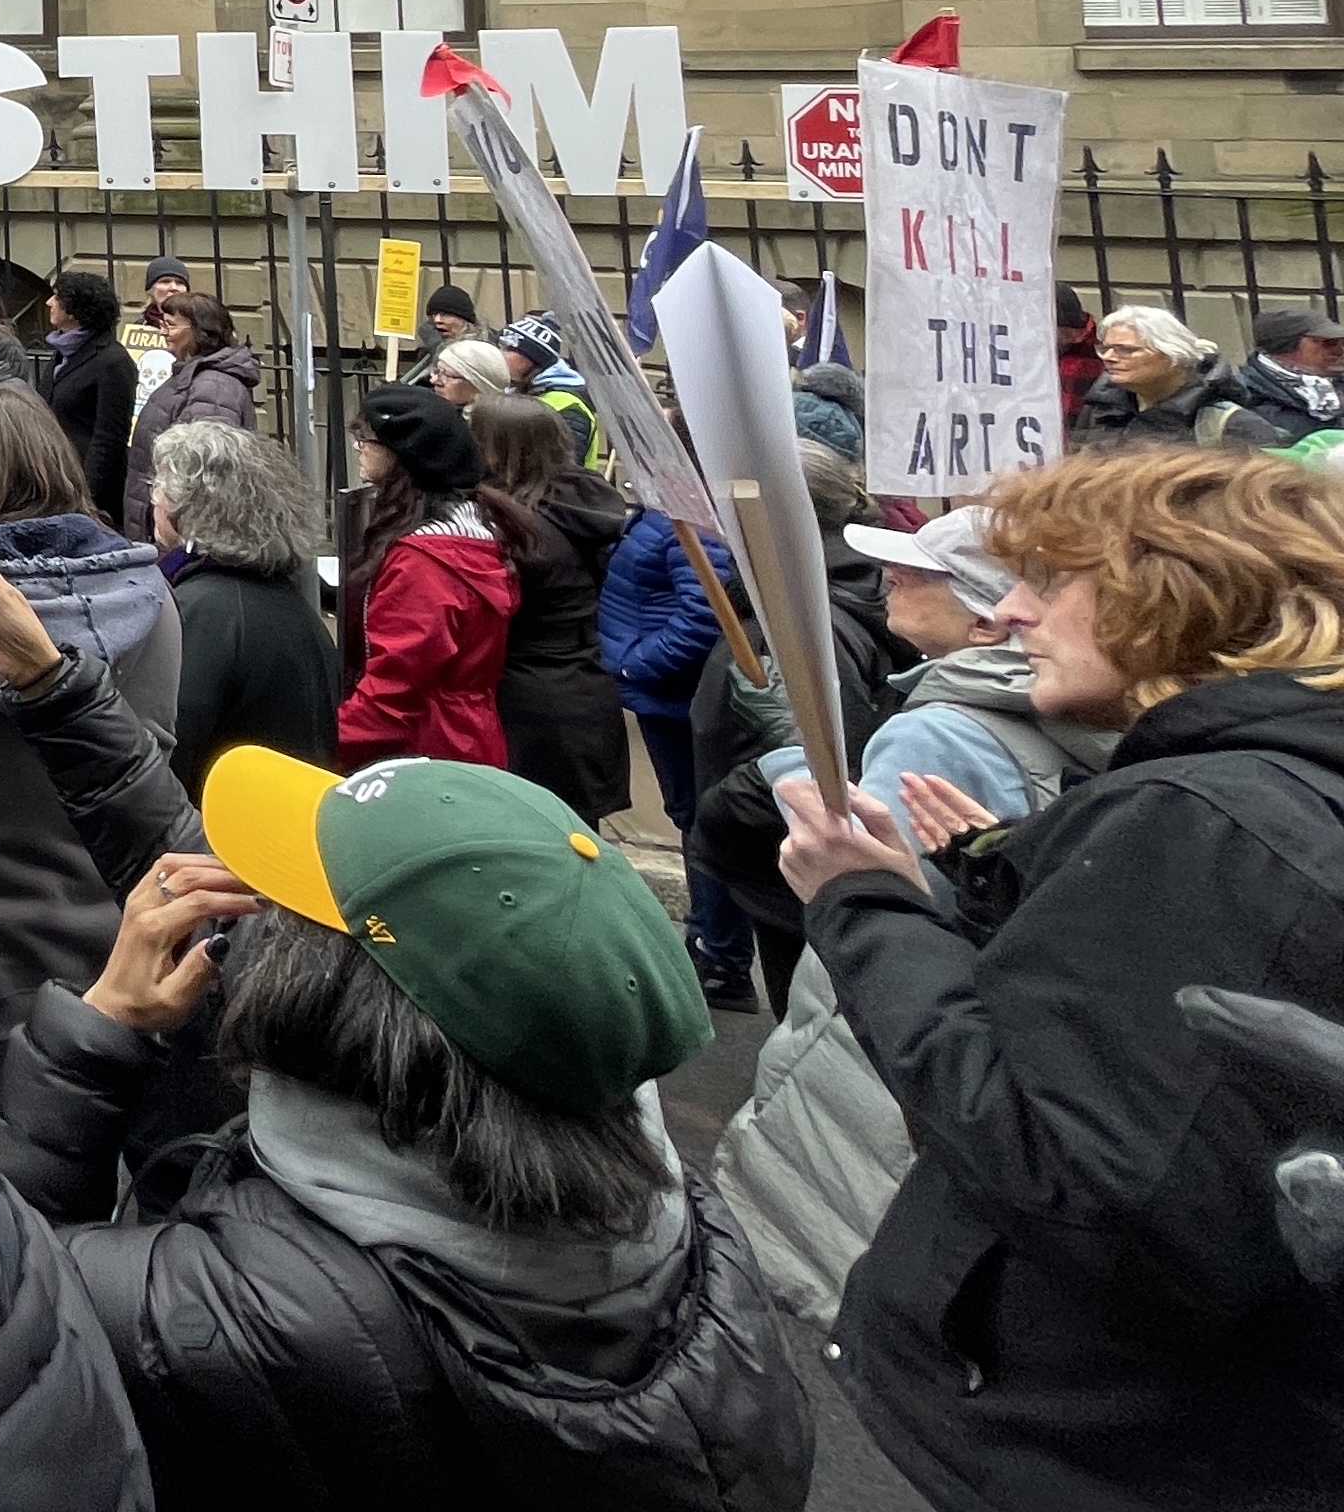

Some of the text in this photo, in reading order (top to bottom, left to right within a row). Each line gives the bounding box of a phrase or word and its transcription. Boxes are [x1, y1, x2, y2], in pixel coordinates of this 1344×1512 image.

[901, 207, 1024, 282] KILL
[928, 318, 1012, 386] THE
[906, 411, 1044, 476] ARTS
